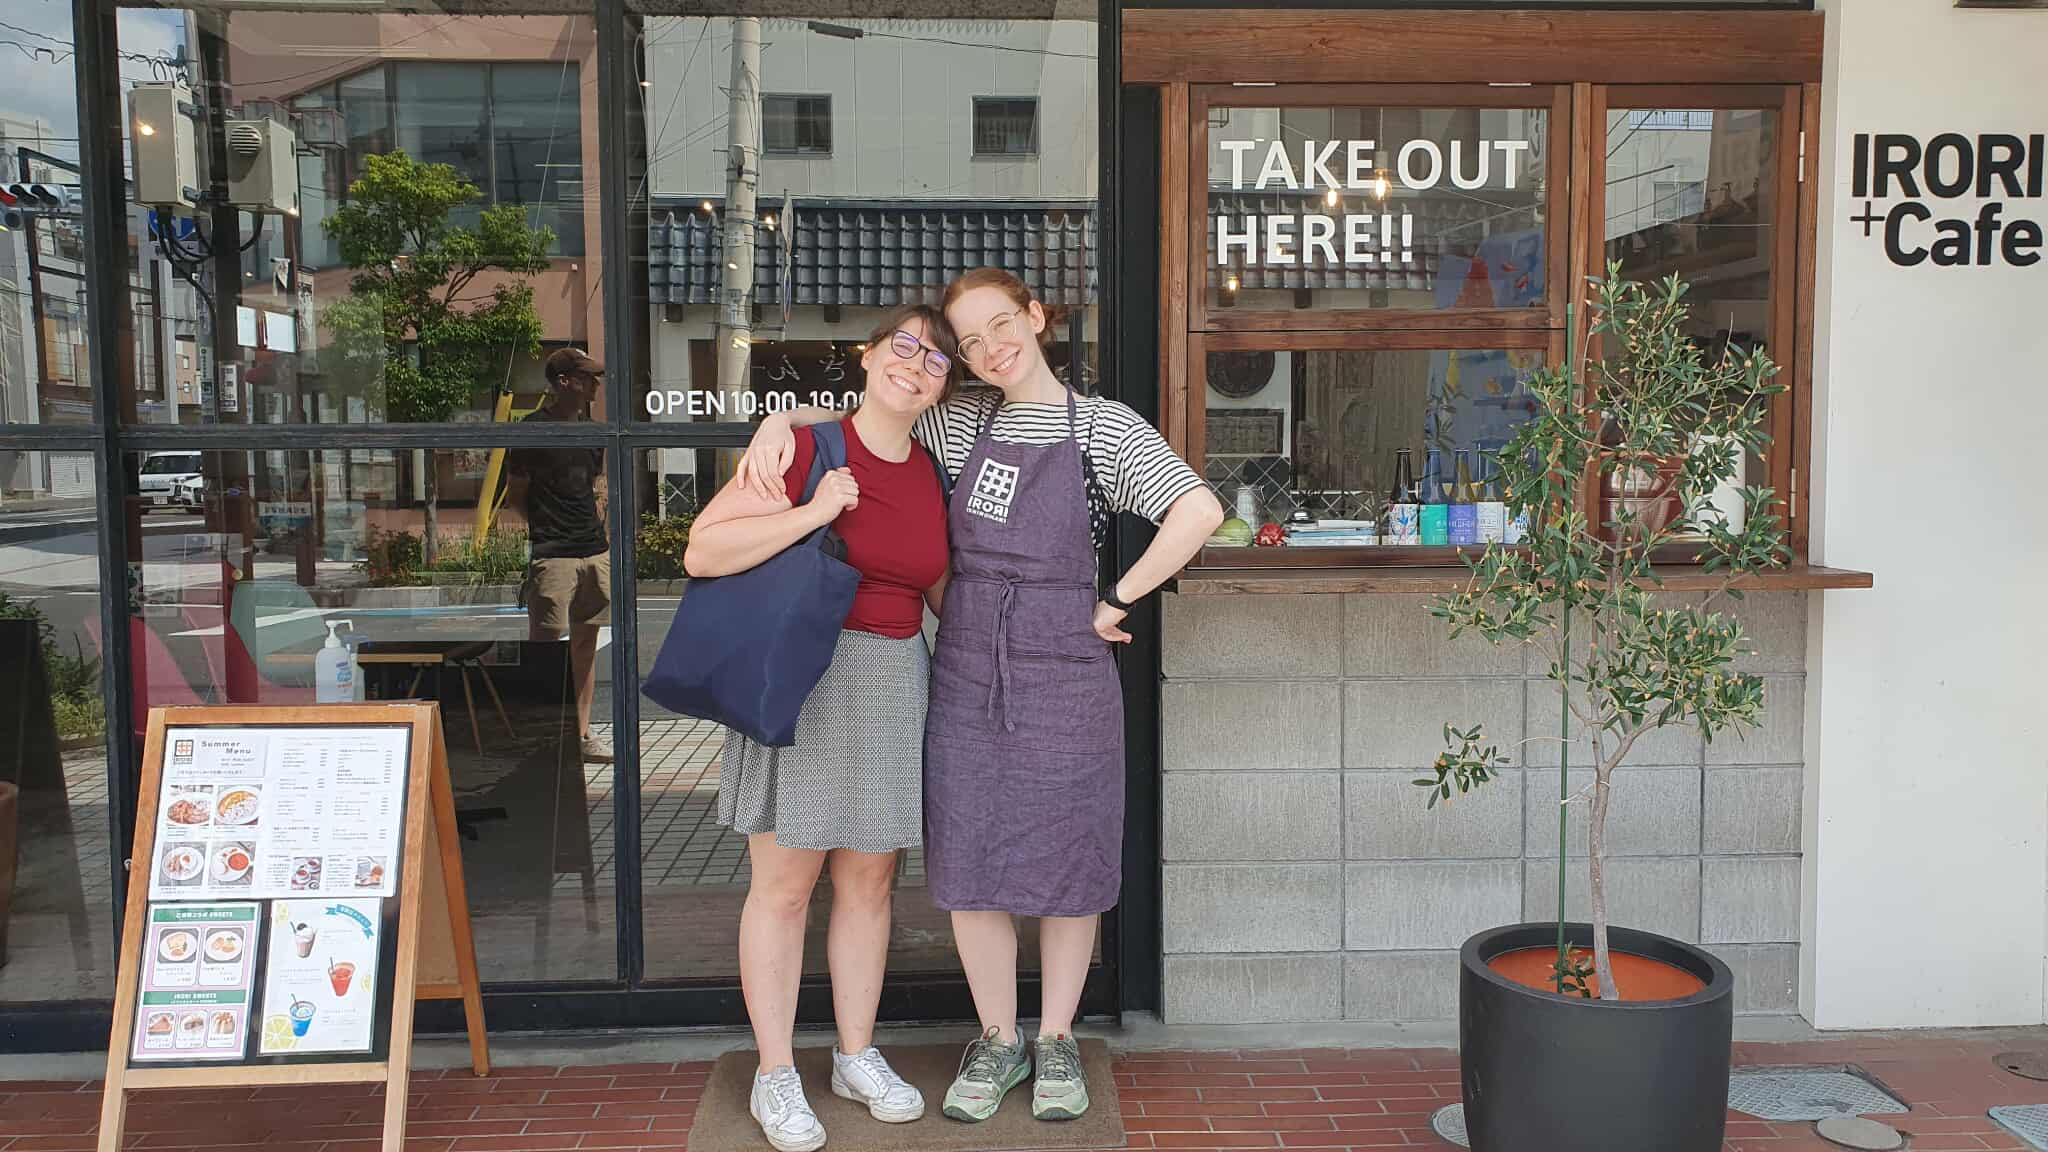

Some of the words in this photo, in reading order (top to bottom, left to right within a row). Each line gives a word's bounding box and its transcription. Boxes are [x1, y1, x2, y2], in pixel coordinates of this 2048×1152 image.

[1219, 138, 1378, 191] TAKE
[1396, 138, 1529, 191] OUT
[1852, 132, 2045, 199] IRORI
[1216, 213, 1414, 265] HERE!!
[645, 389, 725, 416] OPEN
[730, 389, 865, 416] 10:00-19:0
[967, 496, 1008, 517] IRORI
[201, 740, 241, 748] Summer
